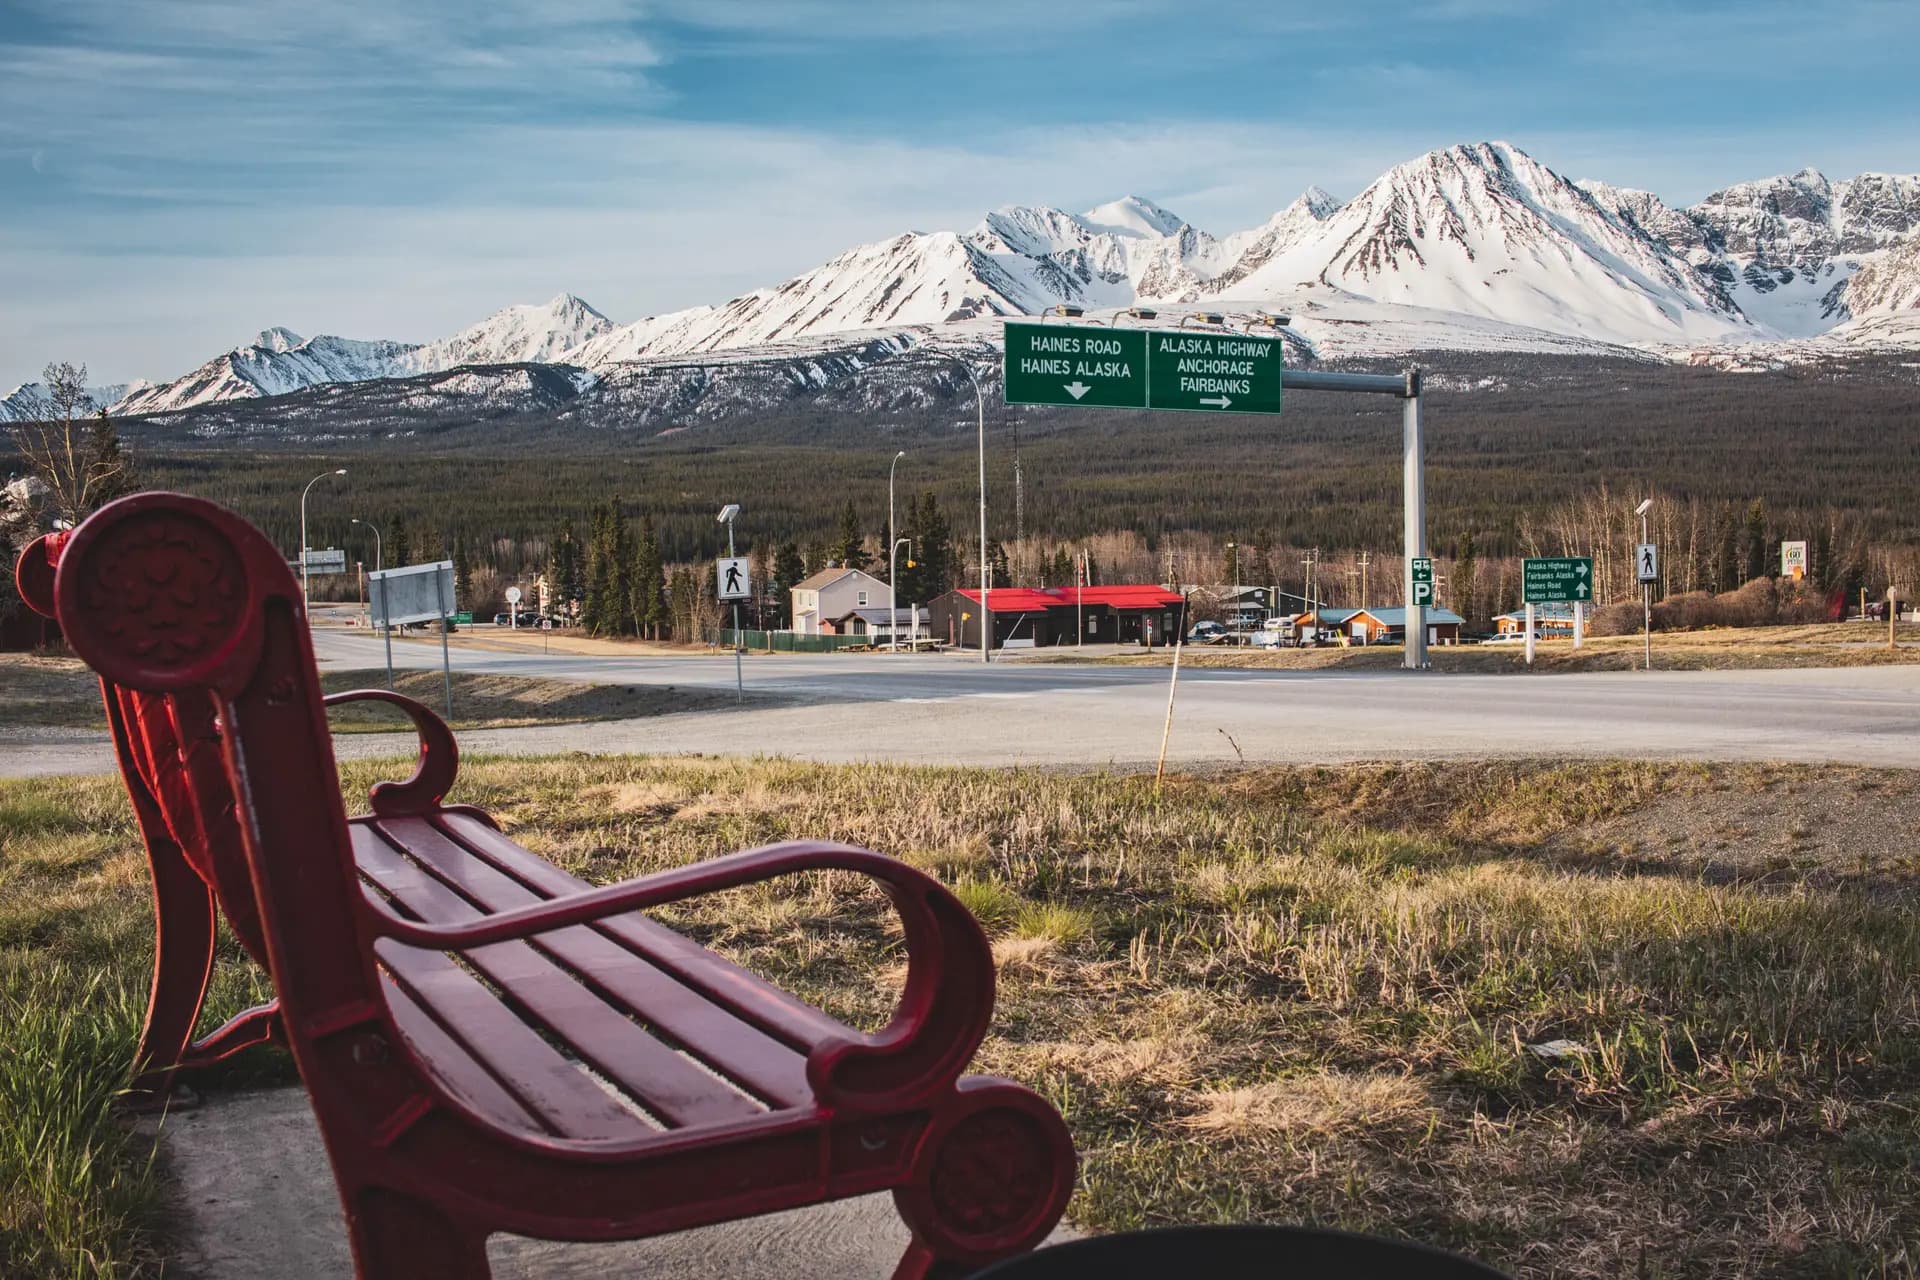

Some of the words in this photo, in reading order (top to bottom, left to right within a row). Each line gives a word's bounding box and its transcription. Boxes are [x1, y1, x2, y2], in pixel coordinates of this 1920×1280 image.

[1031, 336, 1080, 353] HAINES
[1086, 339, 1122, 355] ROAD
[1160, 338, 1213, 355] ALASKA
[1217, 341, 1272, 358] HIGHWAY
[1021, 359, 1070, 375] HAINES
[1076, 361, 1131, 377] ALASKA
[1177, 359, 1255, 376] ANCHORAGE
[1180, 377, 1251, 394] FAIRBANKS
[1527, 562, 1547, 570] Alaska
[1548, 562, 1572, 571] Highway
[1527, 572, 1554, 580] Fairbanks
[1414, 583, 1430, 605] P
[1527, 582, 1546, 590] Haines
[1548, 581, 1561, 589] Road
[1527, 592, 1546, 600] Haines
[1548, 591, 1567, 599] Alaska
